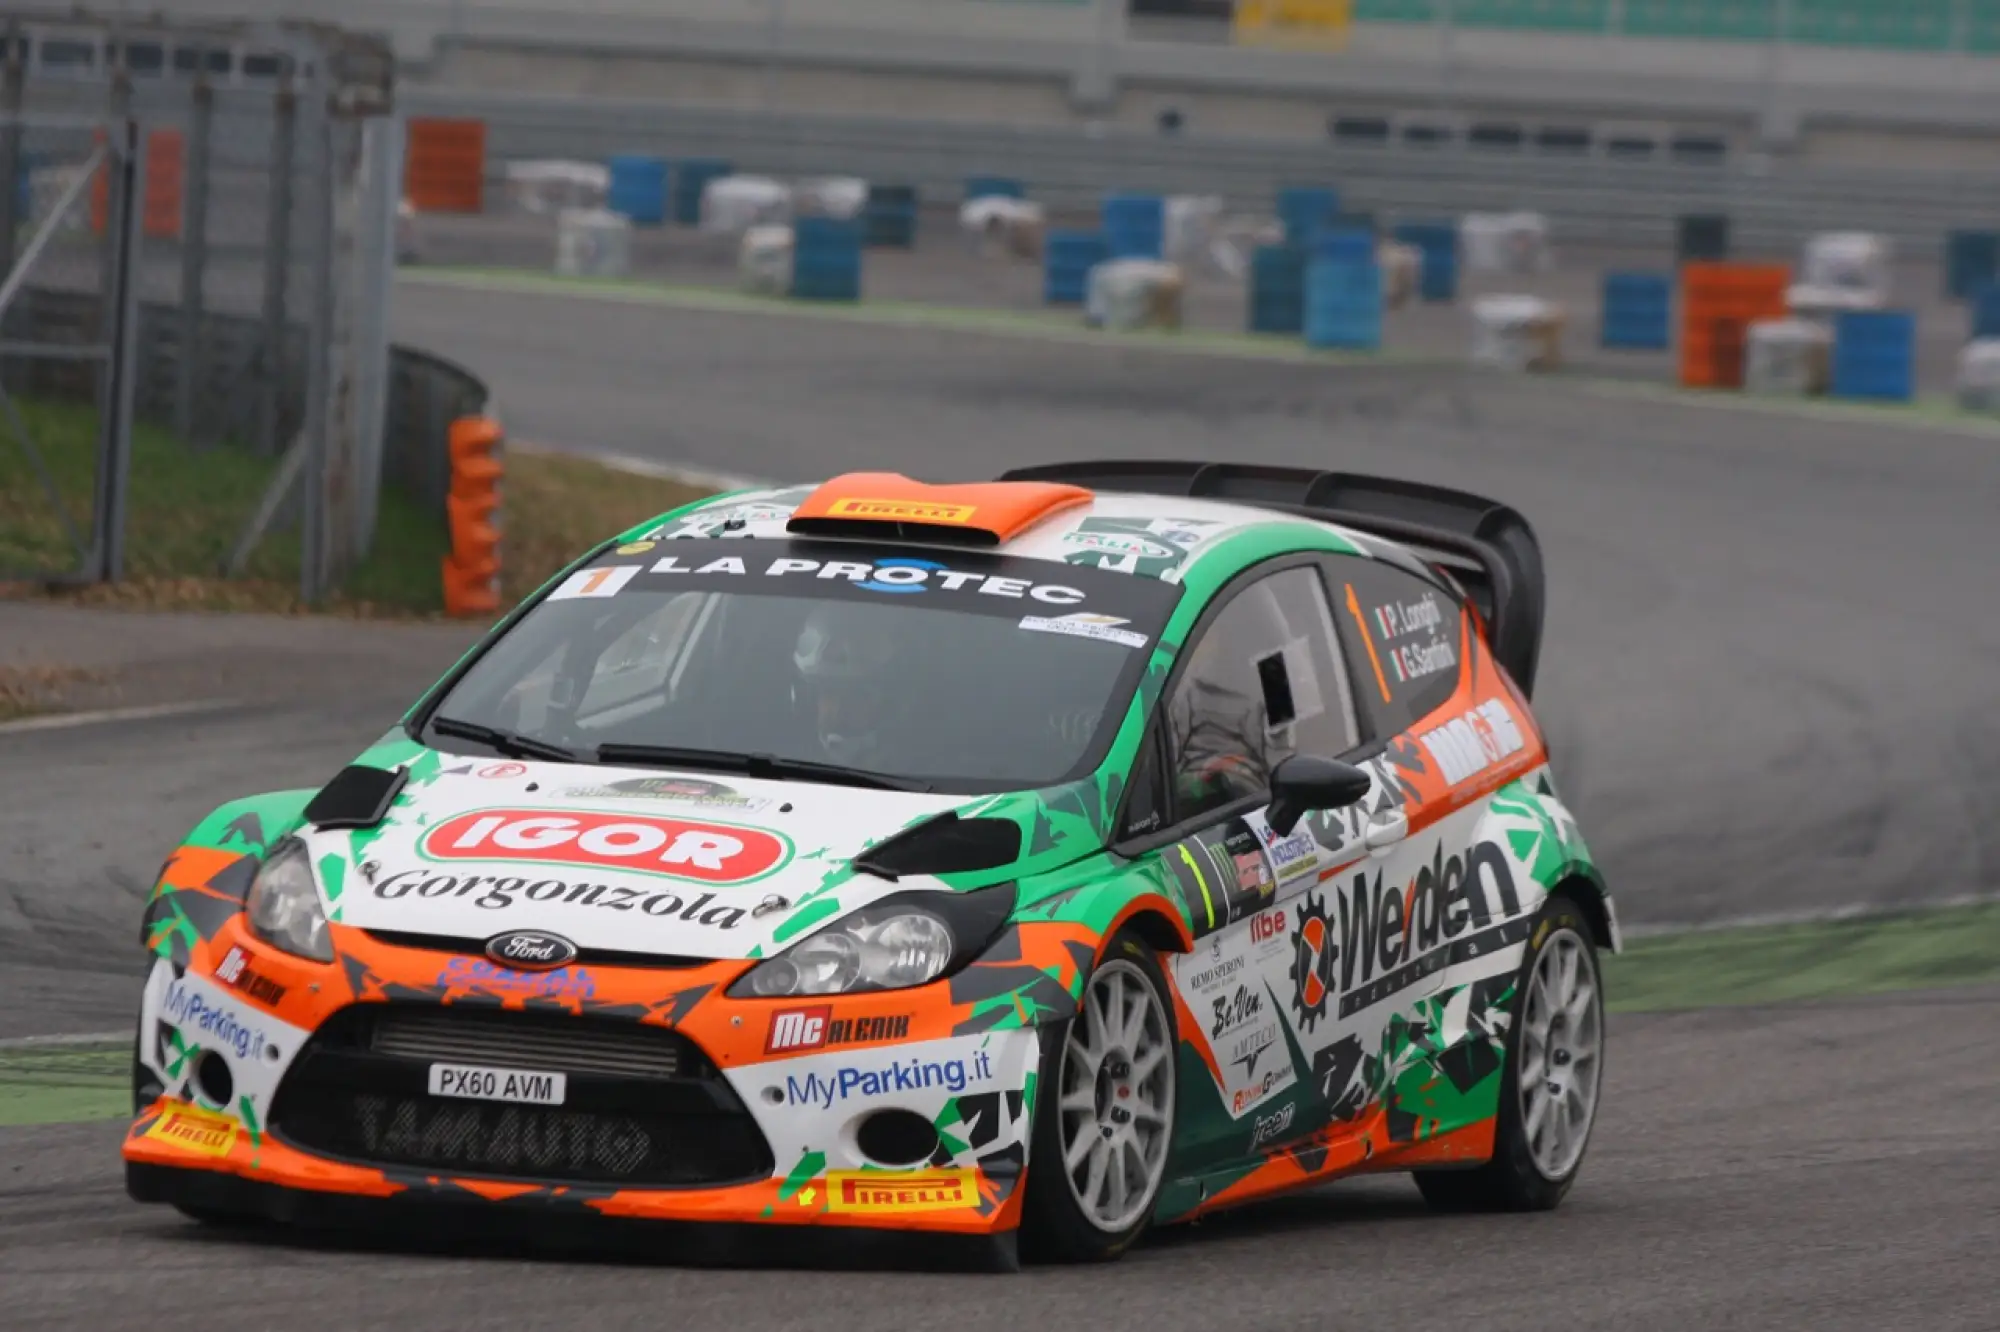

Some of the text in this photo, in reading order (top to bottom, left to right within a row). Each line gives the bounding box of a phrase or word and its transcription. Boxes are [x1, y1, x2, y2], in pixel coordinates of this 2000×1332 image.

[846, 502, 961, 518] PIRELLI
[580, 567, 615, 594] 1
[650, 556, 1086, 604] LA PROTEC
[452, 816, 744, 870] IGOR
[374, 869, 750, 930] Gorgonzola
[1177, 844, 1214, 928] 1
[1336, 837, 1521, 993] Werden
[504, 936, 556, 960] Ford
[440, 1069, 553, 1100] PX60 AVM
[787, 1051, 992, 1109] MyParking.it
[161, 1113, 231, 1149] PIRELLI
[842, 1178, 963, 1205] PIRELLI
